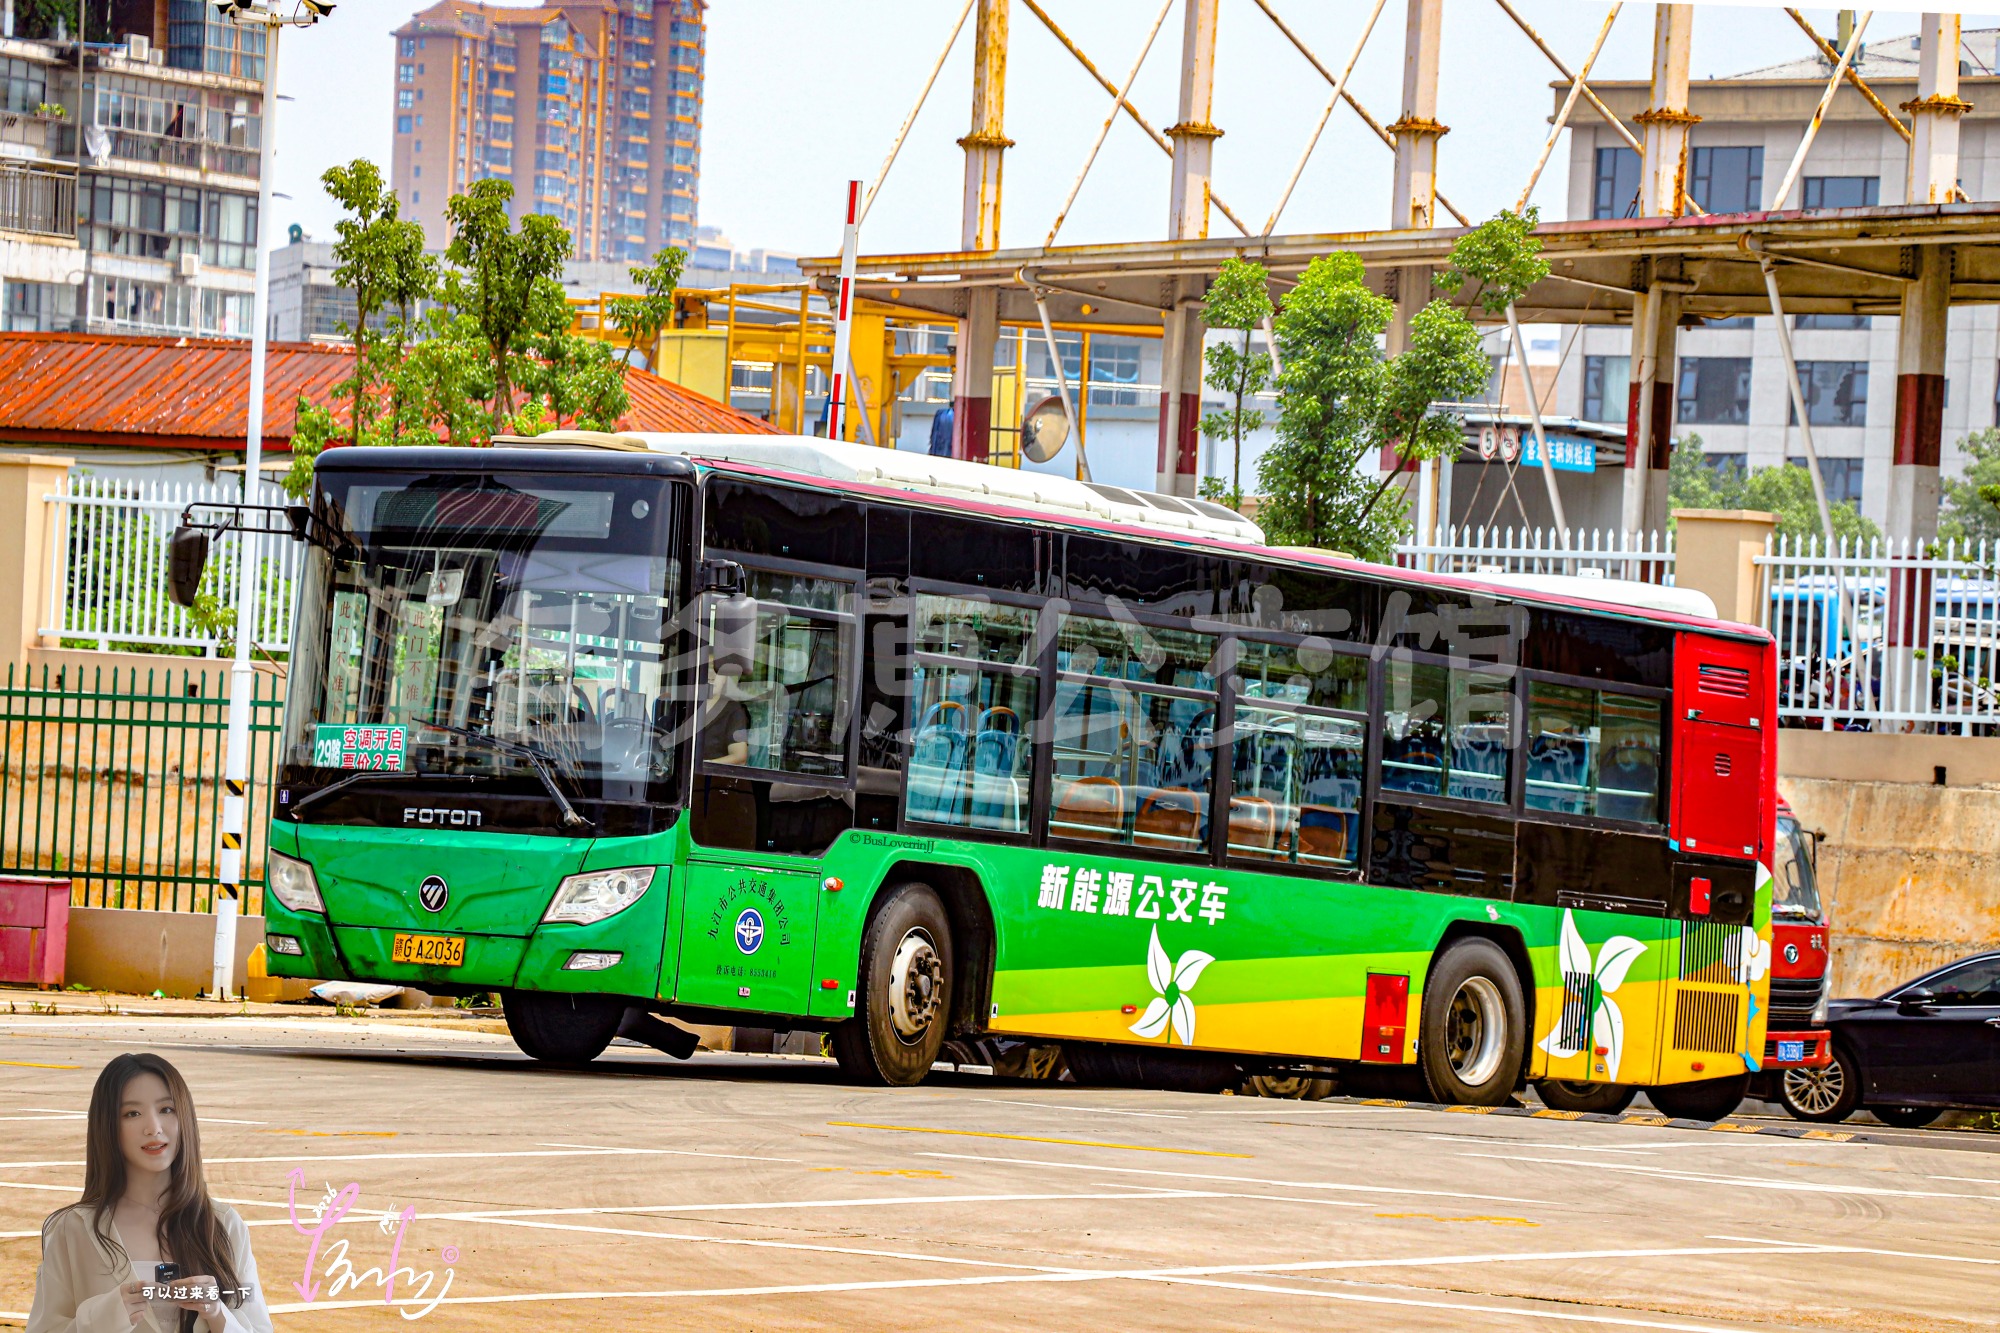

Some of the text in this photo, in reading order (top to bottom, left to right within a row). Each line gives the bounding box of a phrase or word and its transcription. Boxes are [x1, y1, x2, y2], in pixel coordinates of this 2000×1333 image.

[342, 728, 403, 750] 空调开启
[317, 738, 341, 768] 29路
[341, 752, 400, 771] 票价2元
[403, 807, 482, 827] FOTON
[1036, 863, 1229, 926] 新能源公交车
[707, 878, 791, 946] 九江市公共交通集团公司
